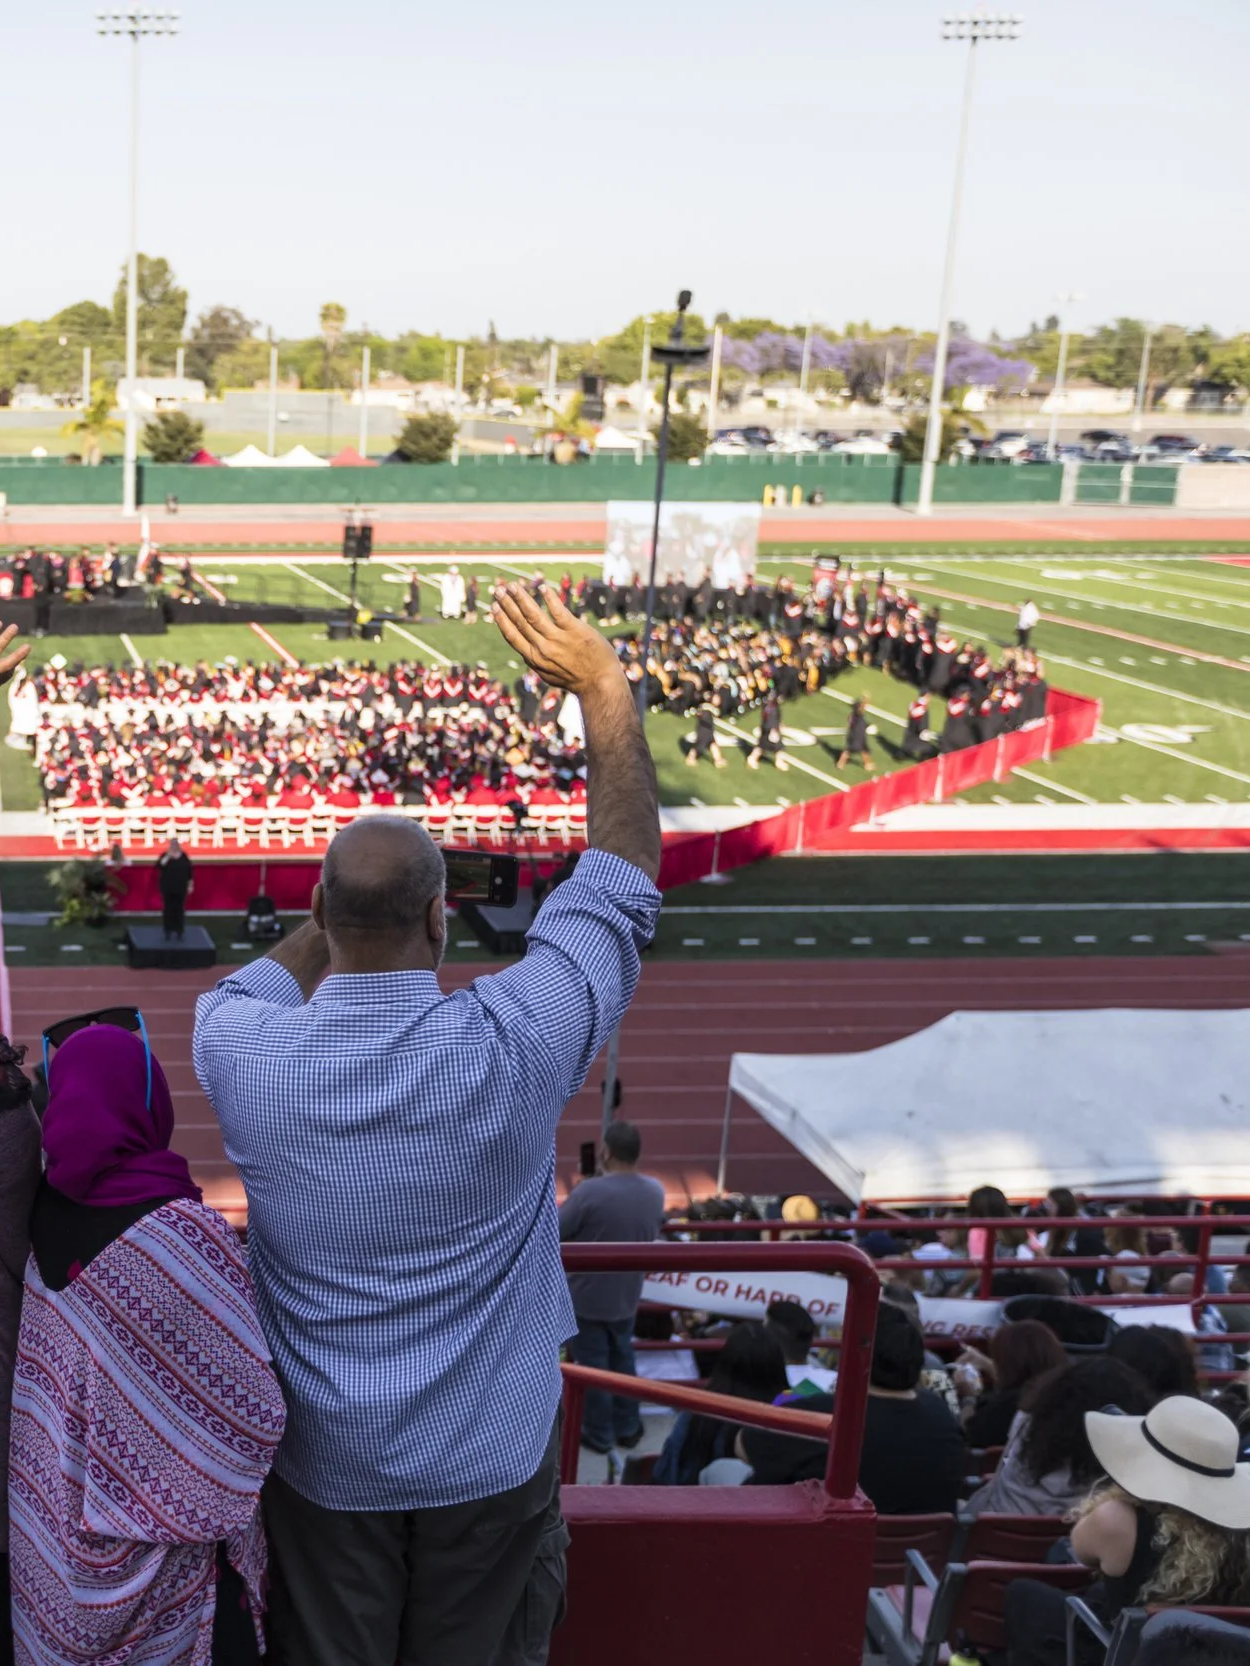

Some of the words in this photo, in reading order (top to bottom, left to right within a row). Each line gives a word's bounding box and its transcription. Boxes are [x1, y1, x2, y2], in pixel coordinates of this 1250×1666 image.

[644, 1271, 690, 1287] EAF
[695, 1276, 729, 1296] OR
[807, 1299, 840, 1316] OF
